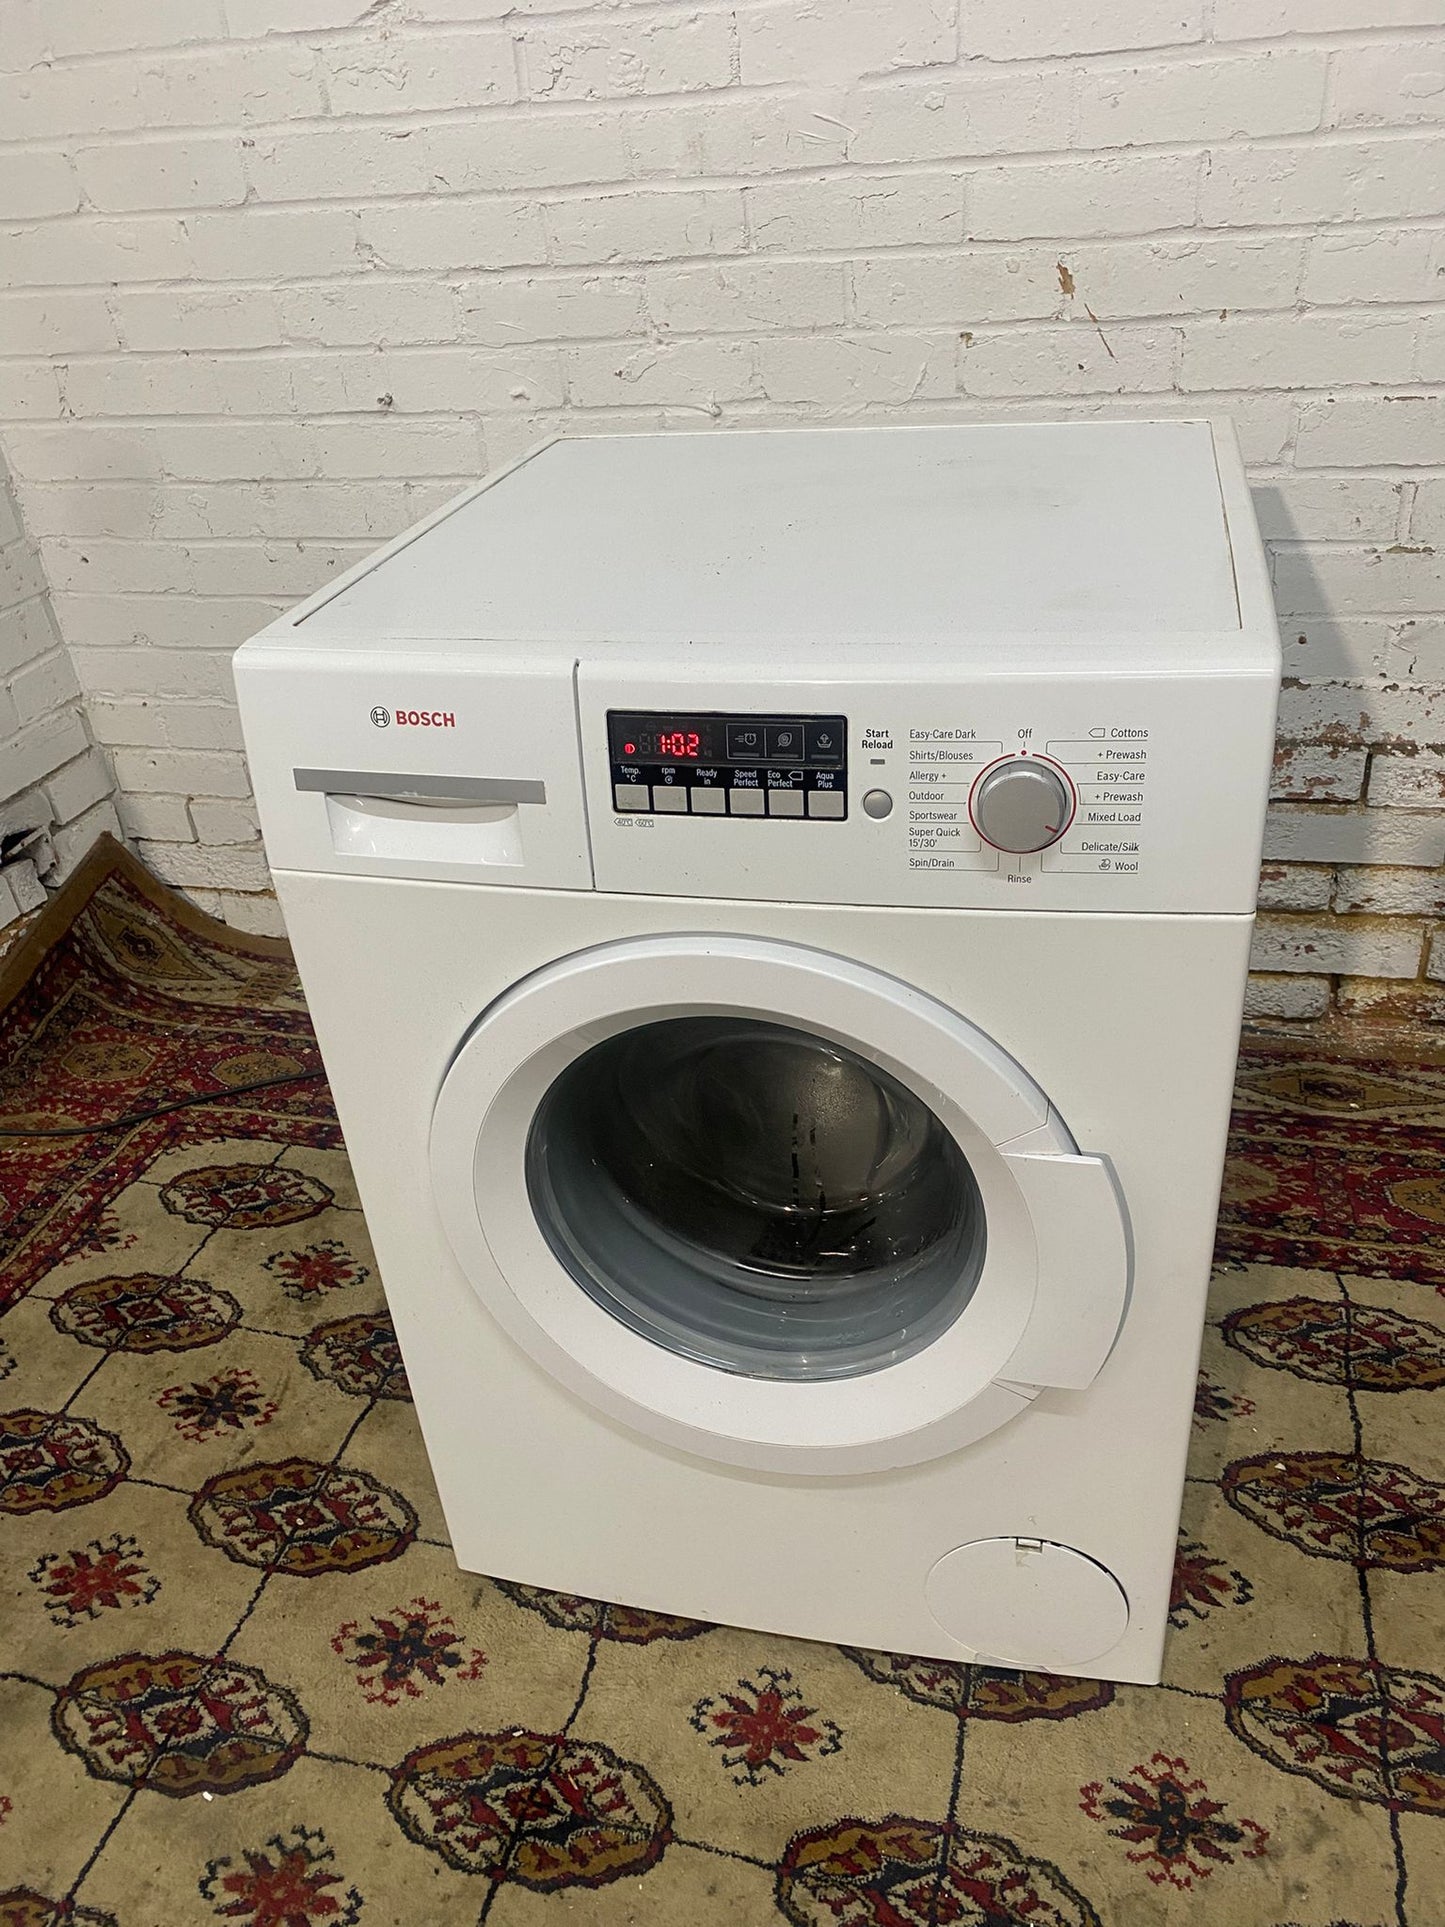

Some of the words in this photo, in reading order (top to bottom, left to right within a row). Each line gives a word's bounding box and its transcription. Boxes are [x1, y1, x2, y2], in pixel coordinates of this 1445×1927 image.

[395, 710, 455, 727] BOSCH
[865, 729, 889, 739] Start
[909, 729, 952, 739] Easy-Care
[955, 729, 976, 739] Dark
[1017, 728, 1032, 738] Off
[1110, 728, 1149, 738] Cottons
[661, 733, 699, 756] 1:02
[861, 740, 893, 750] Reload
[909, 750, 974, 761] Shirts/Blouses
[1106, 750, 1147, 760] Prewash
[620, 765, 641, 775] Temp.
[661, 767, 676, 775] rpm
[696, 768, 717, 778] Ready
[734, 769, 757, 779] Speed
[767, 771, 781, 779] Eco
[816, 772, 834, 781] Aqua
[909, 771, 939, 782] Allergy
[1096, 771, 1145, 782] Easy-Care
[733, 778, 759, 787] Perfect
[767, 779, 793, 788] Perfect
[817, 780, 833, 788] Plus
[908, 791, 944, 800] Outdoor
[1103, 792, 1144, 802] Prewash
[909, 811, 957, 822] Sportswear
[1087, 813, 1116, 822] Mixed
[1118, 813, 1141, 822] Load
[909, 828, 934, 838] Super
[936, 828, 961, 838] Quick
[1081, 842, 1140, 852] Delicate/Silk
[909, 858, 955, 869] Spin/Drain
[1115, 861, 1138, 871] Wool
[1007, 874, 1032, 883] Rinse
